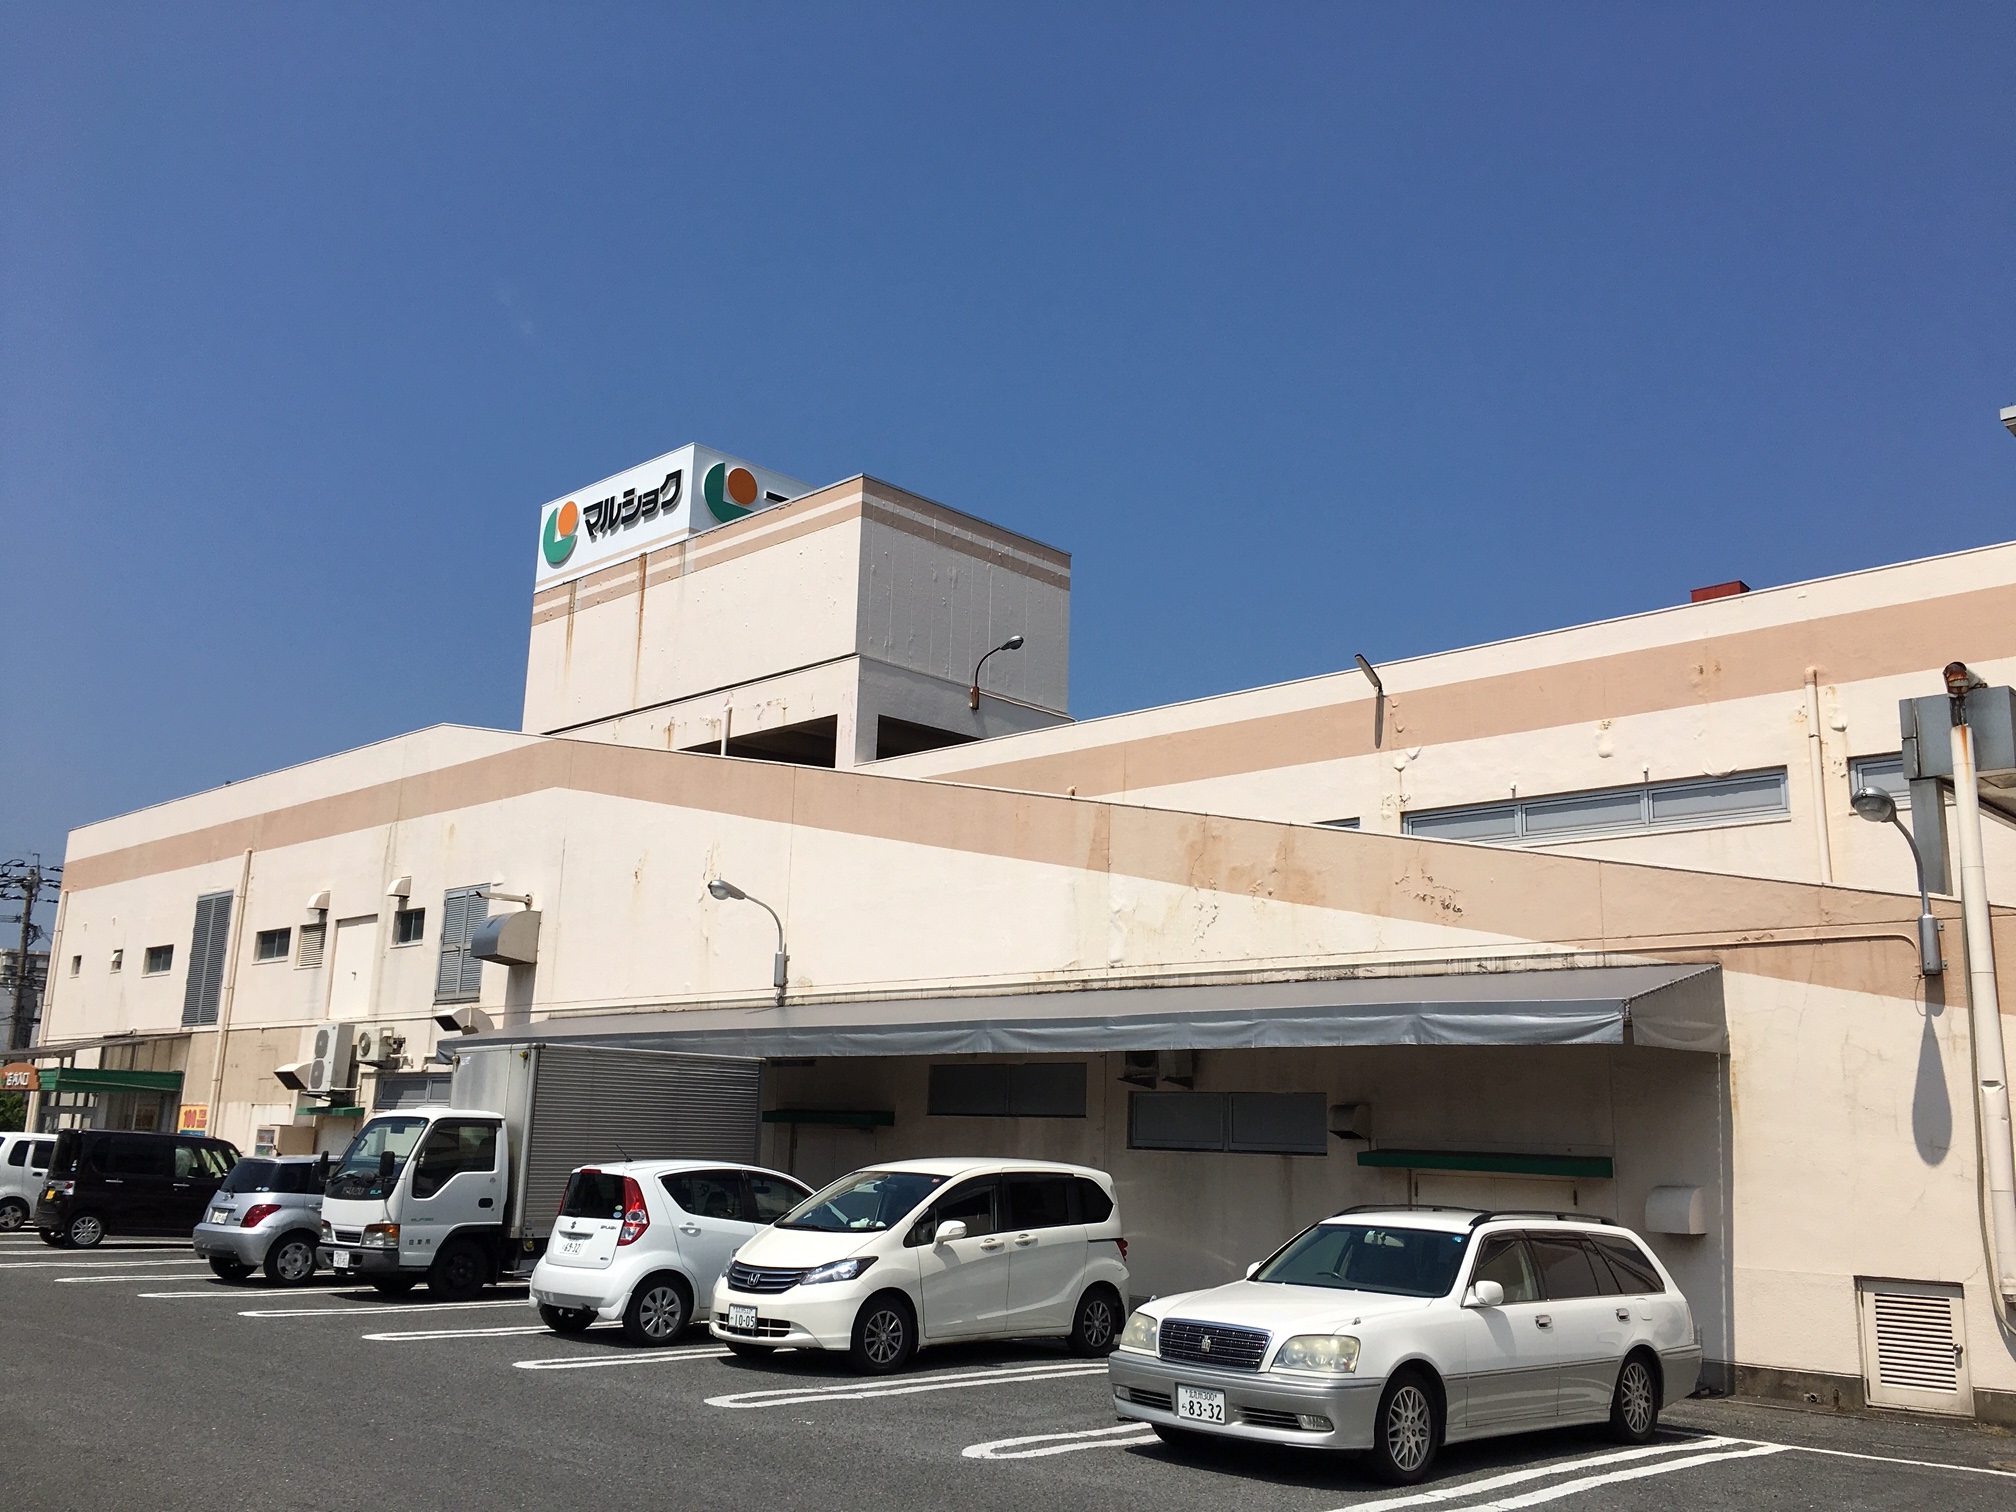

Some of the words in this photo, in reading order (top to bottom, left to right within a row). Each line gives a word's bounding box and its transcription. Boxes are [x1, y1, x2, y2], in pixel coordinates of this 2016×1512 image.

[583, 468, 684, 540] マルショク
[564, 1242, 581, 1253] 69-32
[735, 1314, 755, 1328] 10-05
[1188, 1400, 1222, 1420] 83-32
